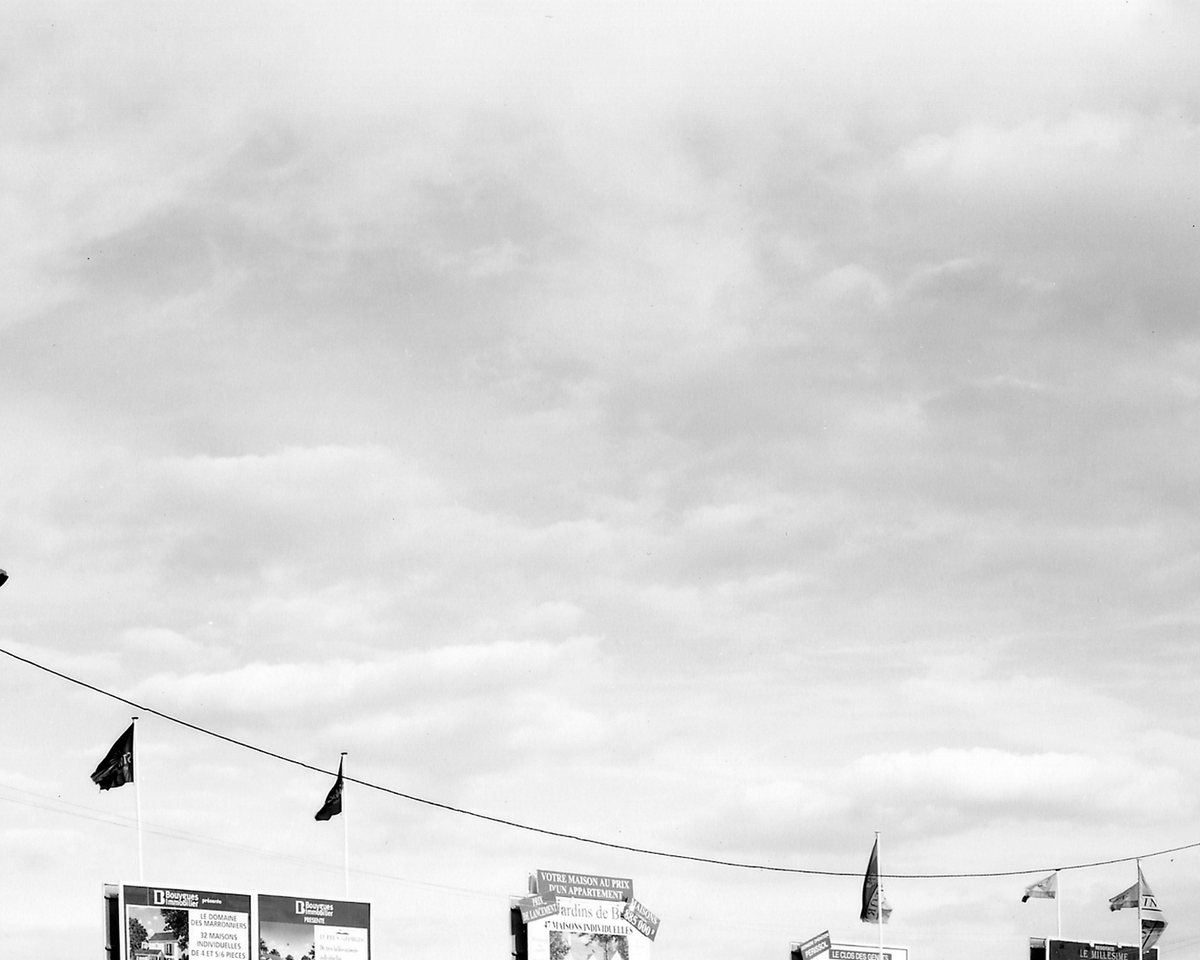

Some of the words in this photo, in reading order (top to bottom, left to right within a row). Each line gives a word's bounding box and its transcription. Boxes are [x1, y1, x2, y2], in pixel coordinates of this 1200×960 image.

[540, 872, 567, 883] VOTRE
[567, 875, 598, 886] MAISON
[599, 879, 610, 887] AU
[611, 880, 630, 889] PRIX
[165, 890, 199, 900] Bouygues
[568, 886, 623, 899] APPARTEMENT
[596, 905, 608, 919] de
[209, 914, 237, 922] DOMAINE
[204, 920, 247, 929] MARRONNIERS
[209, 932, 237, 941] MAISONS
[197, 941, 241, 950] INDIVIDUELLES
[832, 950, 840, 958] LE
[856, 953, 867, 960] DES
[1080, 949, 1088, 958] LE
[1091, 951, 1128, 960] MILLESIME
